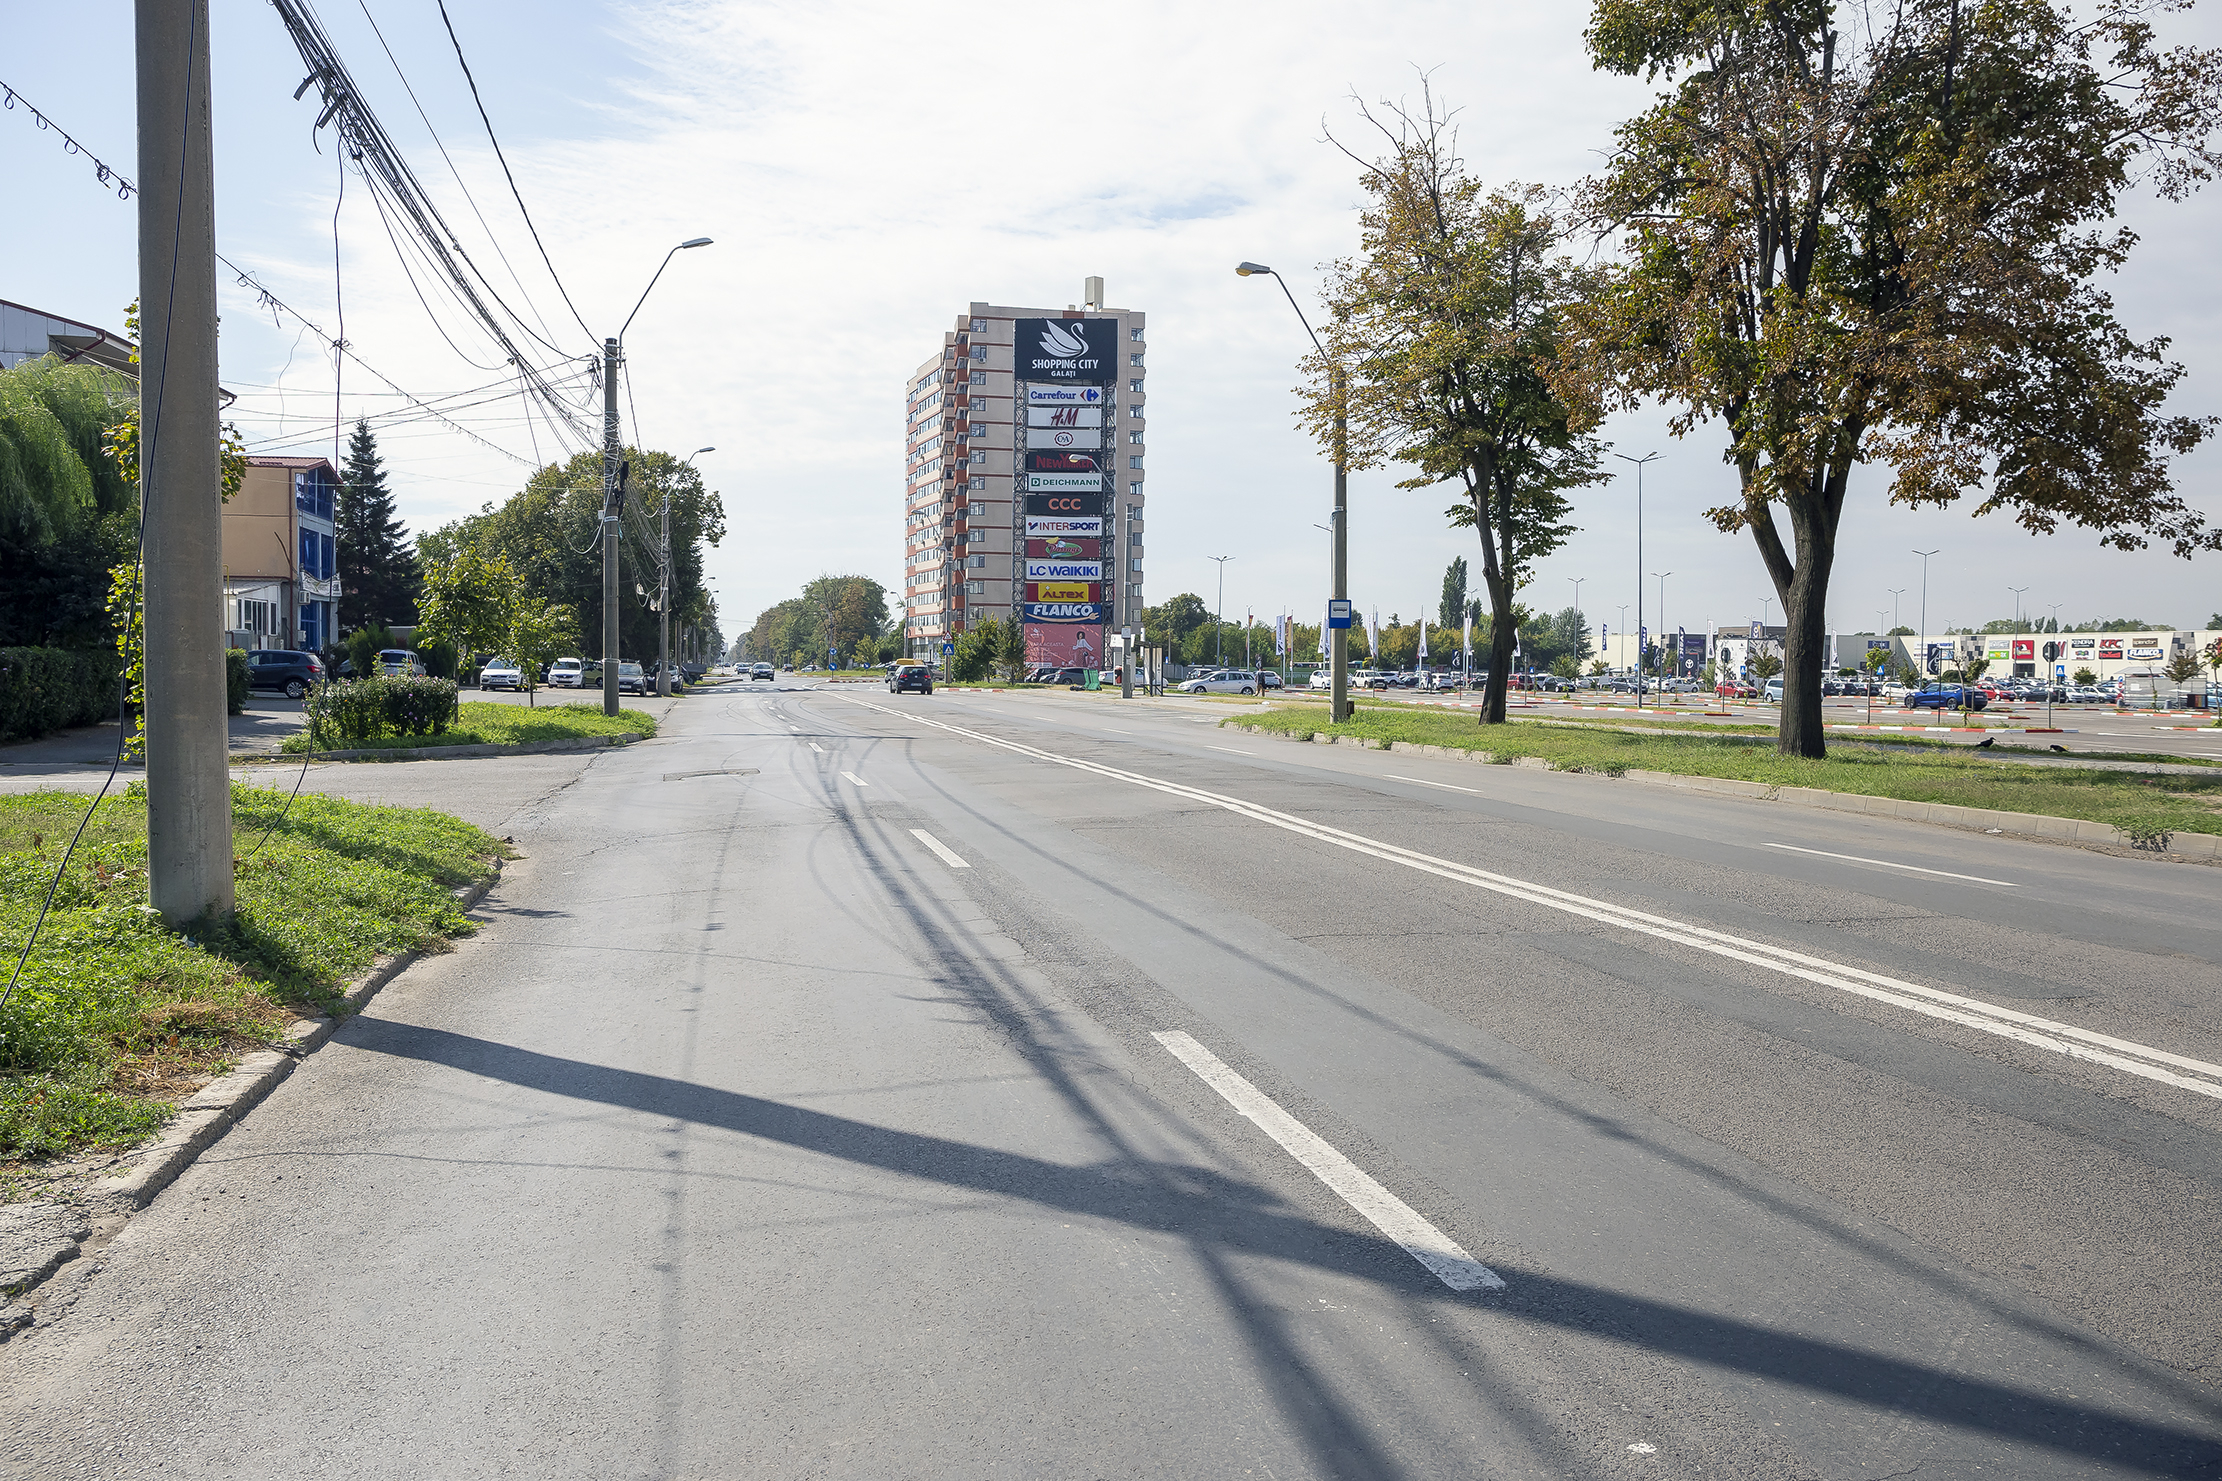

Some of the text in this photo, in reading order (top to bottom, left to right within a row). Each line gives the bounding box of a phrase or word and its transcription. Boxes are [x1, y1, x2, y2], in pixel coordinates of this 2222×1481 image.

[1031, 359, 1099, 369] SHOPPING CITY
[1030, 390, 1077, 399] Carrefour
[1051, 407, 1079, 426] H&M
[1048, 498, 1081, 510] CCC
[1039, 521, 1100, 531] INTERSPORT
[1029, 566, 1047, 576] LC
[1033, 604, 1094, 616] FLANCO
[2099, 639, 2121, 648] KFC
